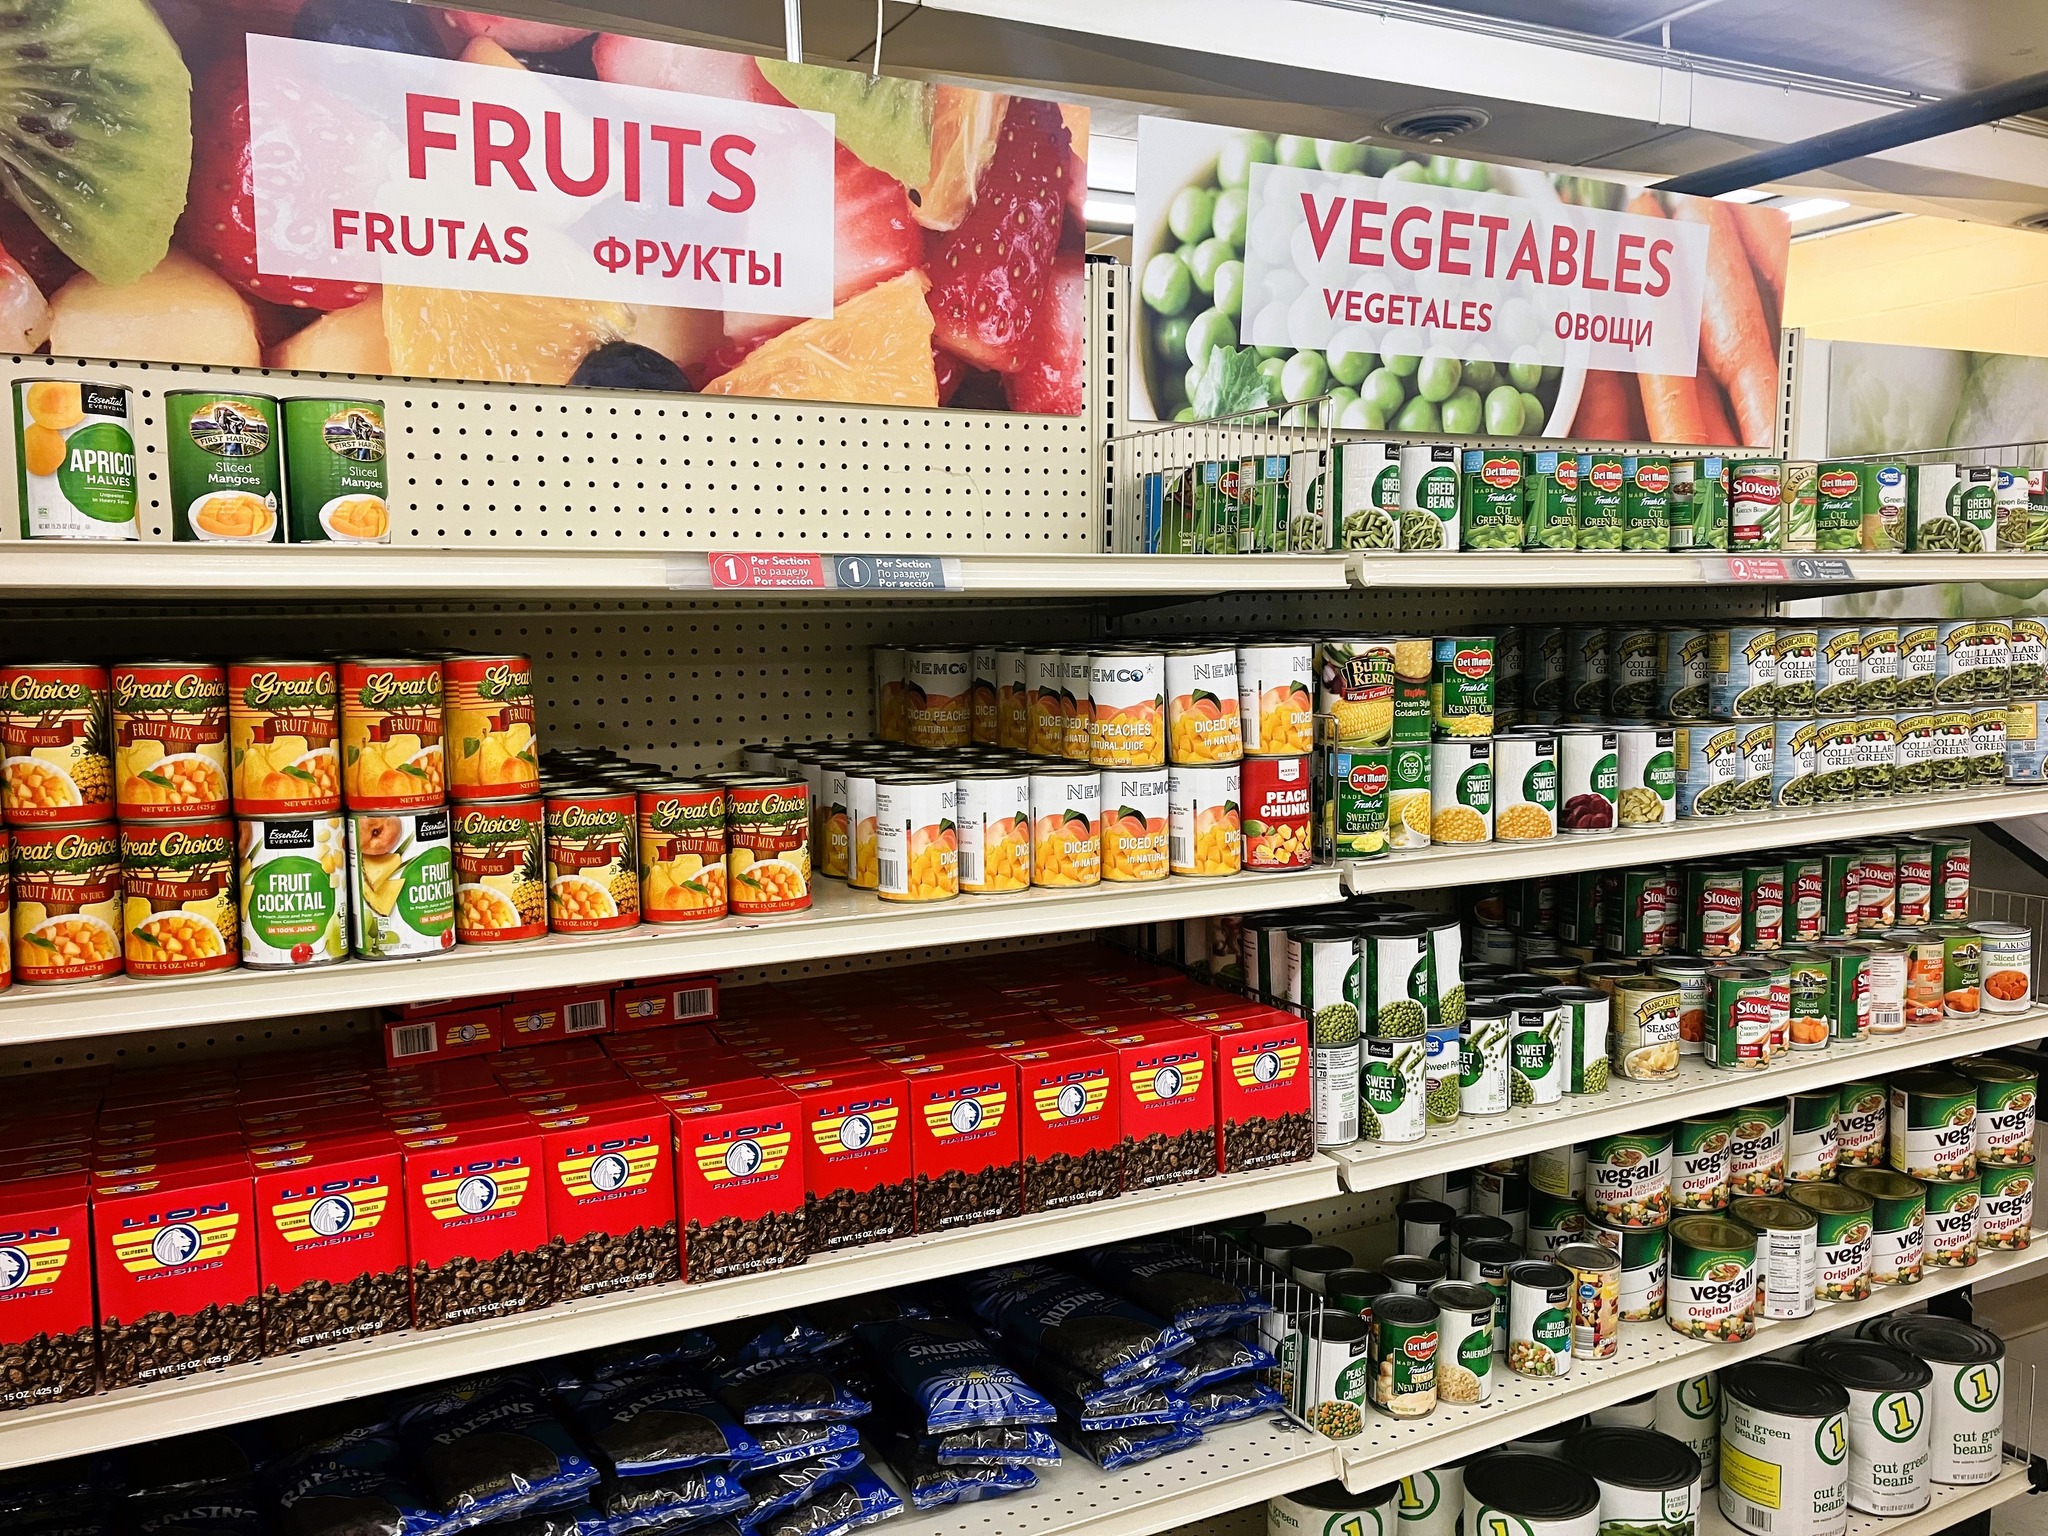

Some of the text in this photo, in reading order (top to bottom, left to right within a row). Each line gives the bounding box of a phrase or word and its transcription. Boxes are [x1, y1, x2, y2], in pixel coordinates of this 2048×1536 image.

[405, 92, 757, 214] FRUITS
[332, 208, 530, 266] FRUTAS
[1300, 193, 1674, 298] VEGETABLES
[593, 236, 783, 289] ФРУКТЫ
[1322, 288, 1492, 333] VEGETALES
[1554, 311, 1653, 353] ОВОЩИ
[87, 392, 123, 408] Essential
[199, 435, 264, 449] FIRST HARVEST
[334, 440, 356, 450] FIRST
[70, 448, 136, 475] APRICOT
[215, 461, 252, 475] Sliced
[349, 466, 378, 478] Sliced
[1485, 467, 1521, 478] Del Monte
[1880, 471, 1900, 481] Great
[87, 473, 130, 487] HALVES
[207, 474, 260, 487] Mangoes
[341, 478, 383, 490] Mangoes
[1788, 472, 1809, 492] EARLY
[1822, 479, 1857, 489] Del Monte
[1428, 483, 1455, 495] GREEN
[1733, 481, 1782, 499] Stokely's
[1427, 496, 1455, 510] BEANS
[1487, 494, 1517, 503] Fresh Cut
[1968, 498, 1992, 510] GREEN
[1495, 505, 1511, 516] CUT
[1602, 508, 1617, 518] CUT
[1648, 509, 1663, 519] CUT
[1967, 509, 1992, 521] BEANS
[1476, 515, 1507, 526] GREEN
[1585, 516, 1611, 527] GREEN
[1630, 518, 1658, 528] GREEN
[751, 556, 811, 567] Per Section
[875, 558, 932, 569] Per Section
[1735, 560, 1747, 577] 2
[724, 558, 738, 582] 1
[753, 567, 809, 579] По разделу
[848, 561, 861, 583] 1
[878, 569, 930, 581] По разделу
[1800, 561, 1812, 577] 3
[754, 576, 813, 586] Por sección
[909, 660, 968, 677] NEMCO
[1456, 658, 1493, 668] Del Monte
[10, 675, 81, 700] Choice
[250, 671, 314, 704] Great
[366, 671, 427, 704] Great
[1347, 689, 1386, 701] Whole Kernel
[1461, 695, 1487, 705] WHOLE
[1395, 700, 1416, 709] Cream
[1448, 703, 1493, 714] KERNEL CORN
[508, 706, 531, 722] FRUIT
[1395, 709, 1415, 717] Golden
[132, 723, 166, 738] FRUIT
[169, 726, 192, 741] MIX
[275, 719, 328, 736] FRUIT MIX
[391, 718, 438, 734] FRUIT MIX
[1102, 723, 1151, 737] PEACHES
[1195, 720, 1226, 734] DICED
[1122, 741, 1144, 751] JUICE
[1933, 745, 1969, 755] GREENS
[1404, 760, 1419, 768] food
[1857, 752, 1894, 762] GREENS
[1404, 767, 1419, 776] club
[1467, 781, 1491, 792] SWEET
[1266, 791, 1307, 804] PEACH
[1470, 793, 1489, 805] CORN
[1536, 789, 1554, 802] CORN
[562, 805, 618, 828] Choice
[1260, 802, 1310, 818] CHUNKS
[1346, 810, 1384, 823] SWEET CORN
[464, 811, 521, 835] Choice
[269, 828, 309, 841] Essential
[55, 834, 117, 860] Choice
[676, 837, 719, 853] FRUIT MIX
[1064, 840, 1093, 854] DICED
[1119, 837, 1150, 850] DICED
[422, 860, 449, 882] FRUIT
[269, 873, 312, 892] FRUIT
[257, 893, 326, 911] COCKTAIL
[276, 926, 291, 934] 100%
[293, 925, 316, 934] JUICE
[1794, 1007, 1819, 1015] Carrots
[1797, 1001, 1818, 1009] Sliced
[1516, 1044, 1546, 1056] SWEET
[1425, 1063, 1450, 1072] Sweet
[1520, 1056, 1544, 1068] PEAS
[1365, 1075, 1396, 1089] SWEET
[1368, 1088, 1392, 1103] PEAS
[1837, 1132, 1876, 1147] Original
[1987, 1131, 2026, 1145] Original
[565, 1135, 650, 1157] LION
[1933, 1144, 1971, 1163] Original
[430, 1156, 521, 1179] LION
[281, 1174, 379, 1199] LION
[1682, 1174, 1721, 1191] Original
[577, 1187, 648, 1206] RAISINS
[1594, 1188, 1632, 1201] Original
[122, 1202, 229, 1229] LION
[442, 1210, 518, 1229] RAISINS
[121, 1232, 228, 1257] CALIFORNIA SEEDLESS
[294, 1231, 375, 1252] RAISINS
[136, 1260, 224, 1283] RAISINS
[1040, 1291, 1105, 1328] RAISINS
[1546, 1321, 1565, 1331] MIXED
[1537, 1328, 1571, 1339] VEGETABLES
[138, 1353, 232, 1379] NET WT. 15 OZ. (425 g)
[1397, 1382, 1414, 1393] NEW
[1889, 1397, 1913, 1435] 1
[434, 1402, 535, 1447] RAISINS
[1734, 1414, 1791, 1441] cut green
[1734, 1424, 1766, 1446] beans
[1953, 1430, 1977, 1443] cut
[1953, 1443, 1993, 1456] beans
[1873, 1452, 1929, 1475] cut green
[1873, 1473, 1914, 1487] beans
